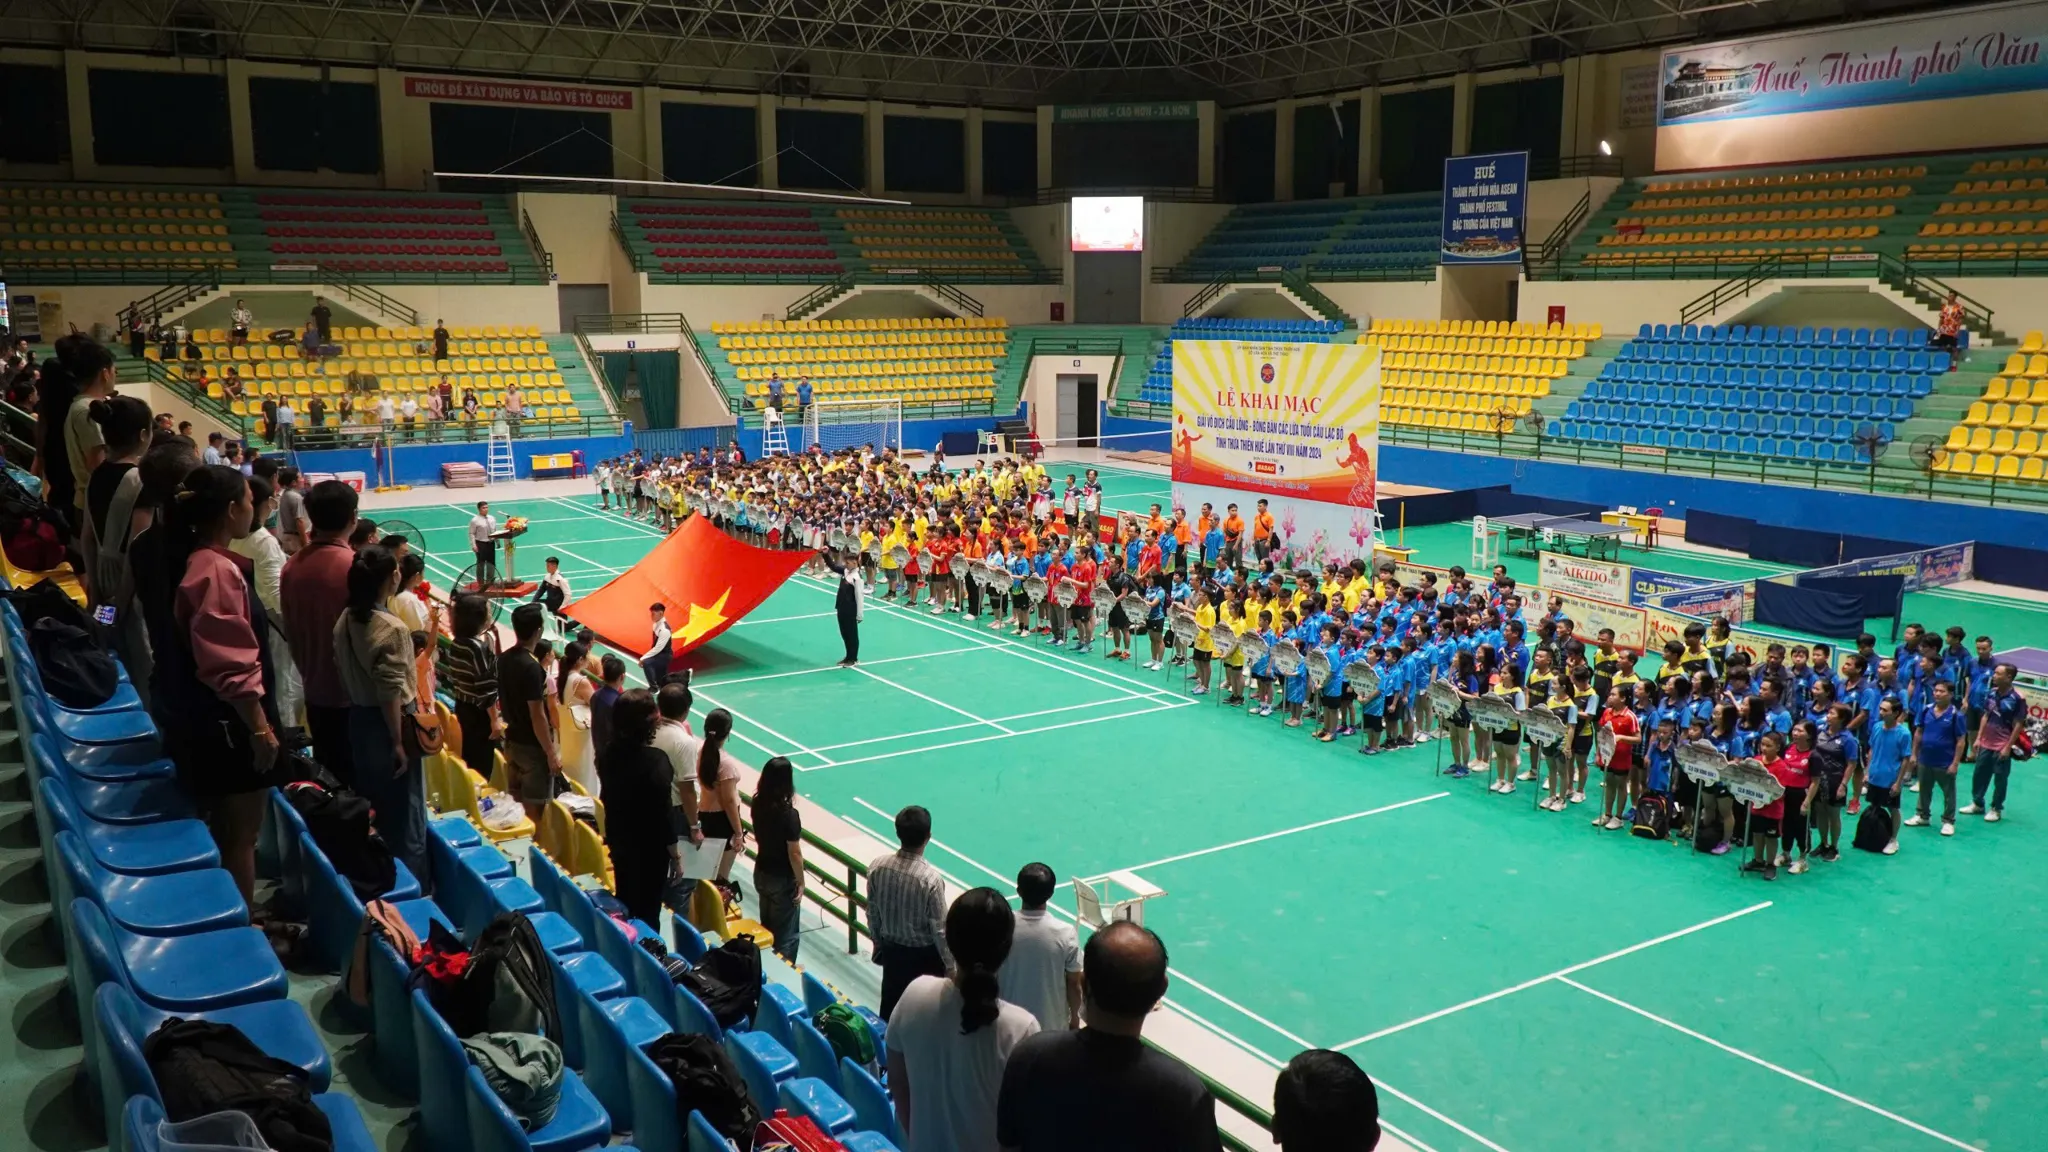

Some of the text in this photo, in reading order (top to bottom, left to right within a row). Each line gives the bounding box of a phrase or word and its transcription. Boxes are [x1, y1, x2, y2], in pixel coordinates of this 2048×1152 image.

[1751, 31, 2040, 96] Huế, Thành phố Văn
[1474, 160, 1496, 180] HUẾ
[1501, 183, 1518, 195] ASEAN
[1486, 200, 1508, 213] FESTIVAL
[1501, 217, 1513, 229] NAM
[1217, 387, 1322, 417] LỄ KHAI MẠC
[1309, 446, 1322, 459] 2024
[1563, 566, 1607, 584] AIKIDO
[1636, 581, 1655, 594] CLB
